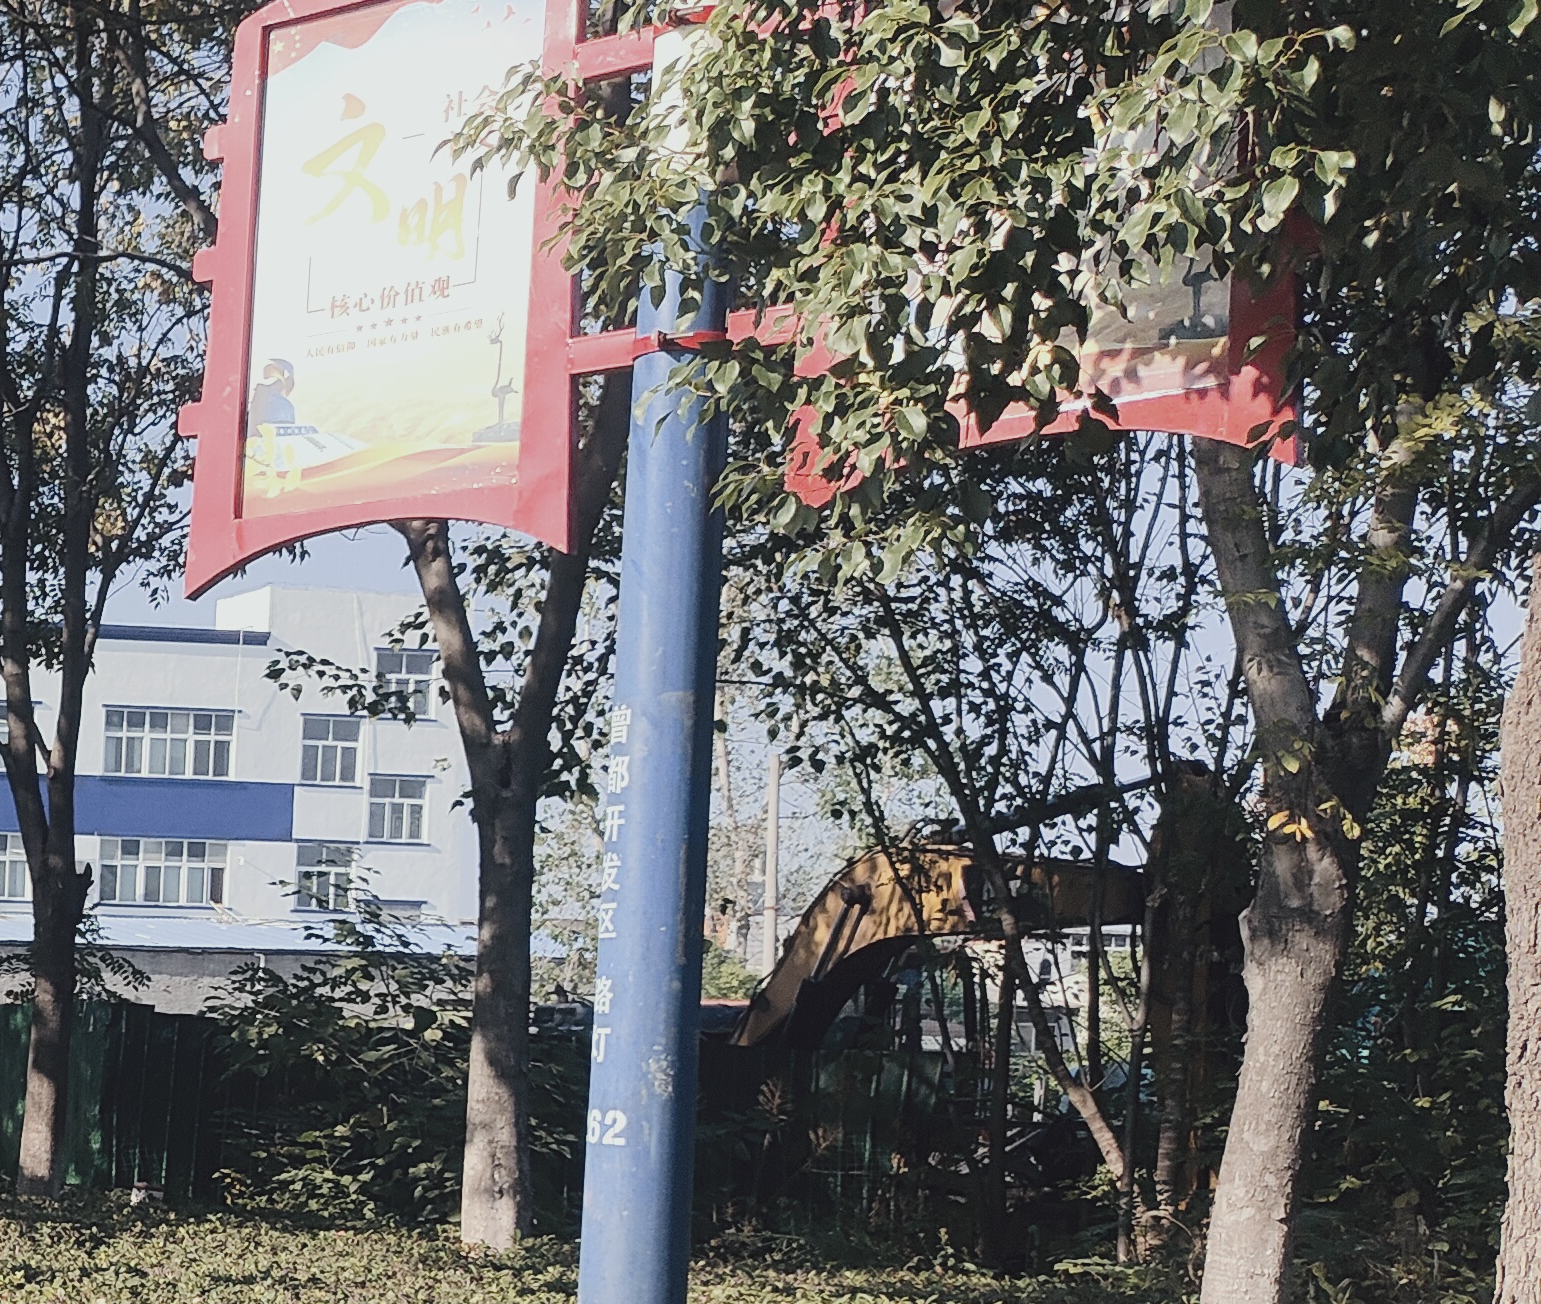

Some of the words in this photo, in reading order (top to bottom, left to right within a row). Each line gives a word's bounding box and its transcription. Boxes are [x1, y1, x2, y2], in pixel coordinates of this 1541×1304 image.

[301, 93, 467, 261] 文明
[330, 276, 450, 319] 核心价值观
[598, 703, 631, 939] 曾都开发区
